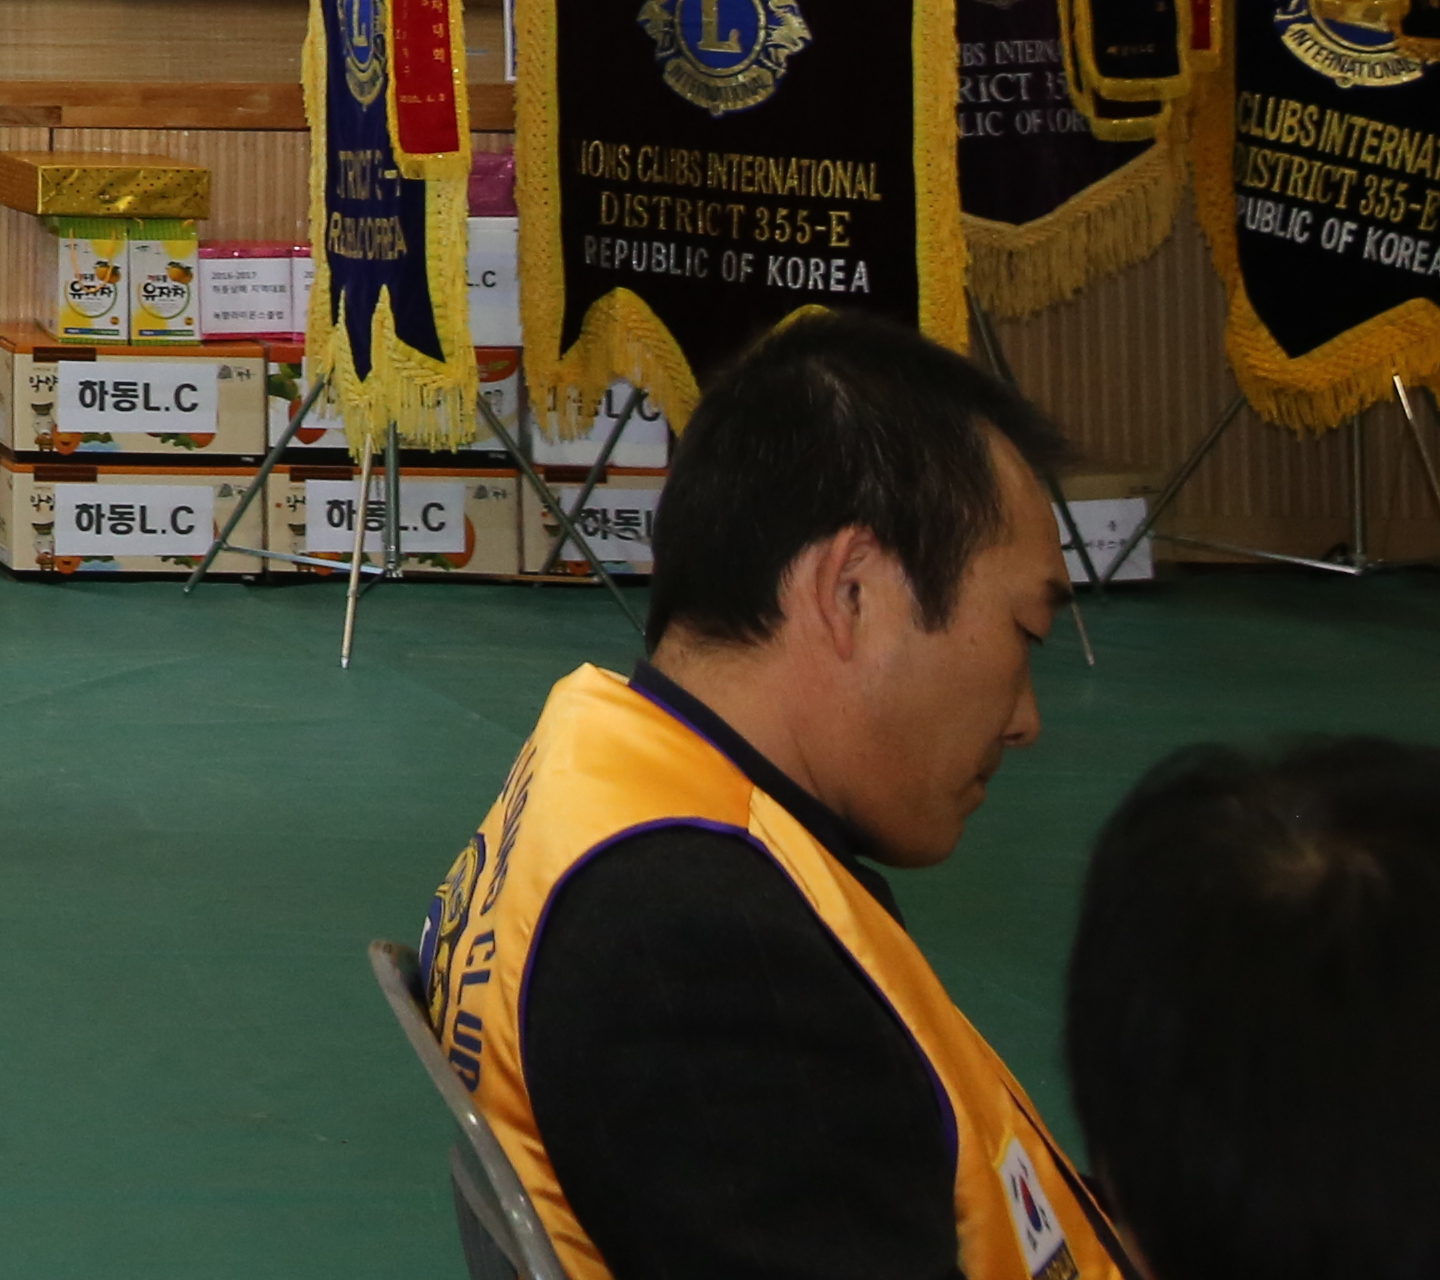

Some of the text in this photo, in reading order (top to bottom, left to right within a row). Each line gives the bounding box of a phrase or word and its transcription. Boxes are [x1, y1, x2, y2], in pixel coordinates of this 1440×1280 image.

[581, 139, 631, 183] IONS
[707, 152, 882, 202] INTERNATIONAL
[600, 190, 852, 248] DISTRICT 355-E
[1320, 216, 1359, 253] OF
[583, 234, 872, 294] REPUBLIC OF KOREA
[78, 379, 199, 413] 하동L.C
[74, 502, 196, 535] 하동L.C
